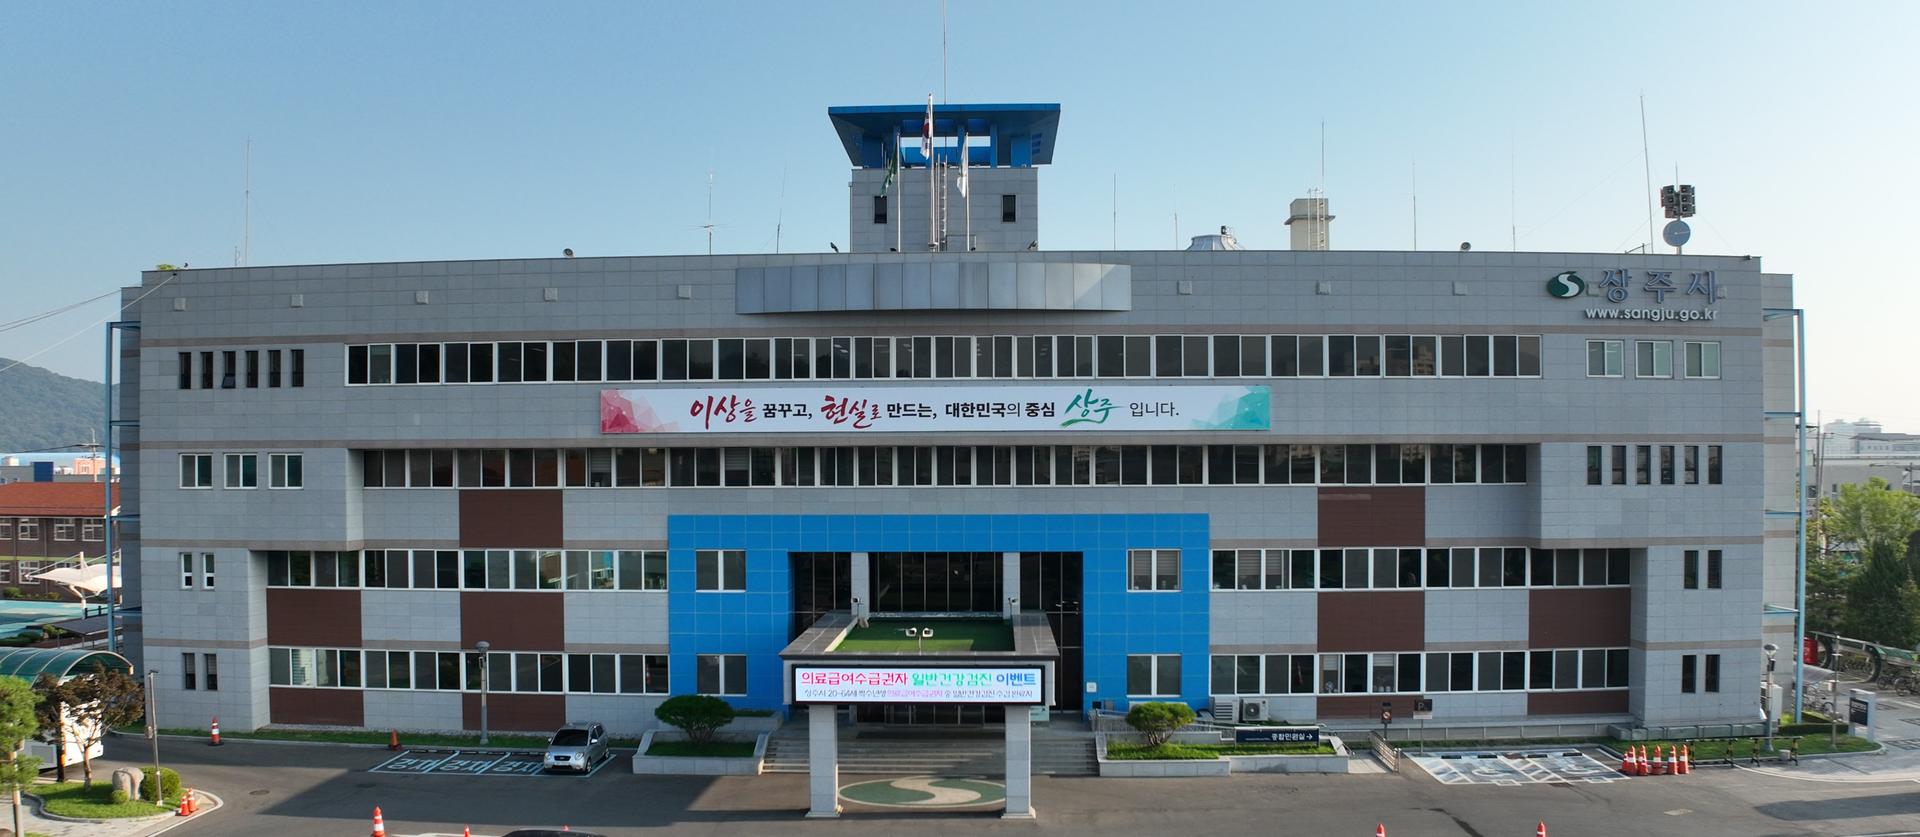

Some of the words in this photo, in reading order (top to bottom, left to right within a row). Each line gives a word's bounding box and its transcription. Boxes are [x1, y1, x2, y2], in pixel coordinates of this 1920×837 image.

[1599, 269, 1717, 304] 상주시
[1586, 308, 1717, 321] www.sangju.go.kr
[690, 395, 758, 430] 이상을
[762, 403, 813, 420] 꿈꾸고,
[820, 395, 883, 429] 현실로
[887, 402, 937, 419] 만드는,
[945, 402, 1021, 418] 대한민국의
[1025, 402, 1055, 418] 중심
[1060, 388, 1127, 428] 상주
[1130, 401, 1180, 417] 입니다.
[801, 672, 908, 686] 의료급여수급권자
[912, 672, 992, 686] 일반건강검진
[996, 672, 1037, 687] 이벤트
